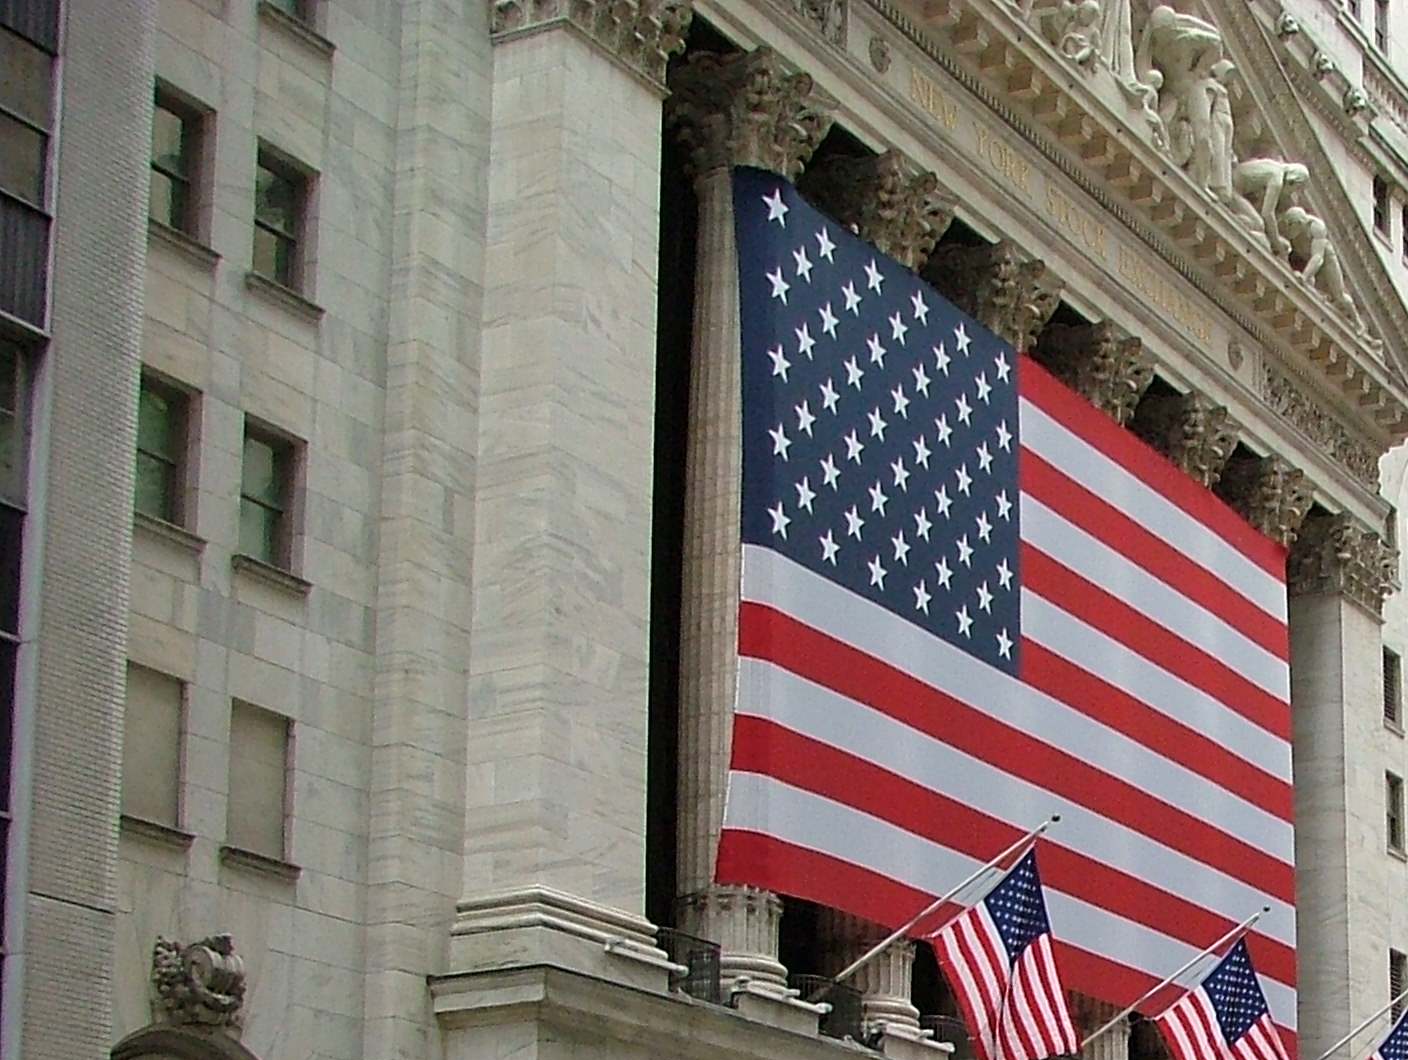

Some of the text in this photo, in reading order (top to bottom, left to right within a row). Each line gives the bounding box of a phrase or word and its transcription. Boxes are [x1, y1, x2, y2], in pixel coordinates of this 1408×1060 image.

[910, 66, 959, 130] NEW
[973, 121, 1033, 199] YORK
[1045, 183, 1107, 262] STOCK
